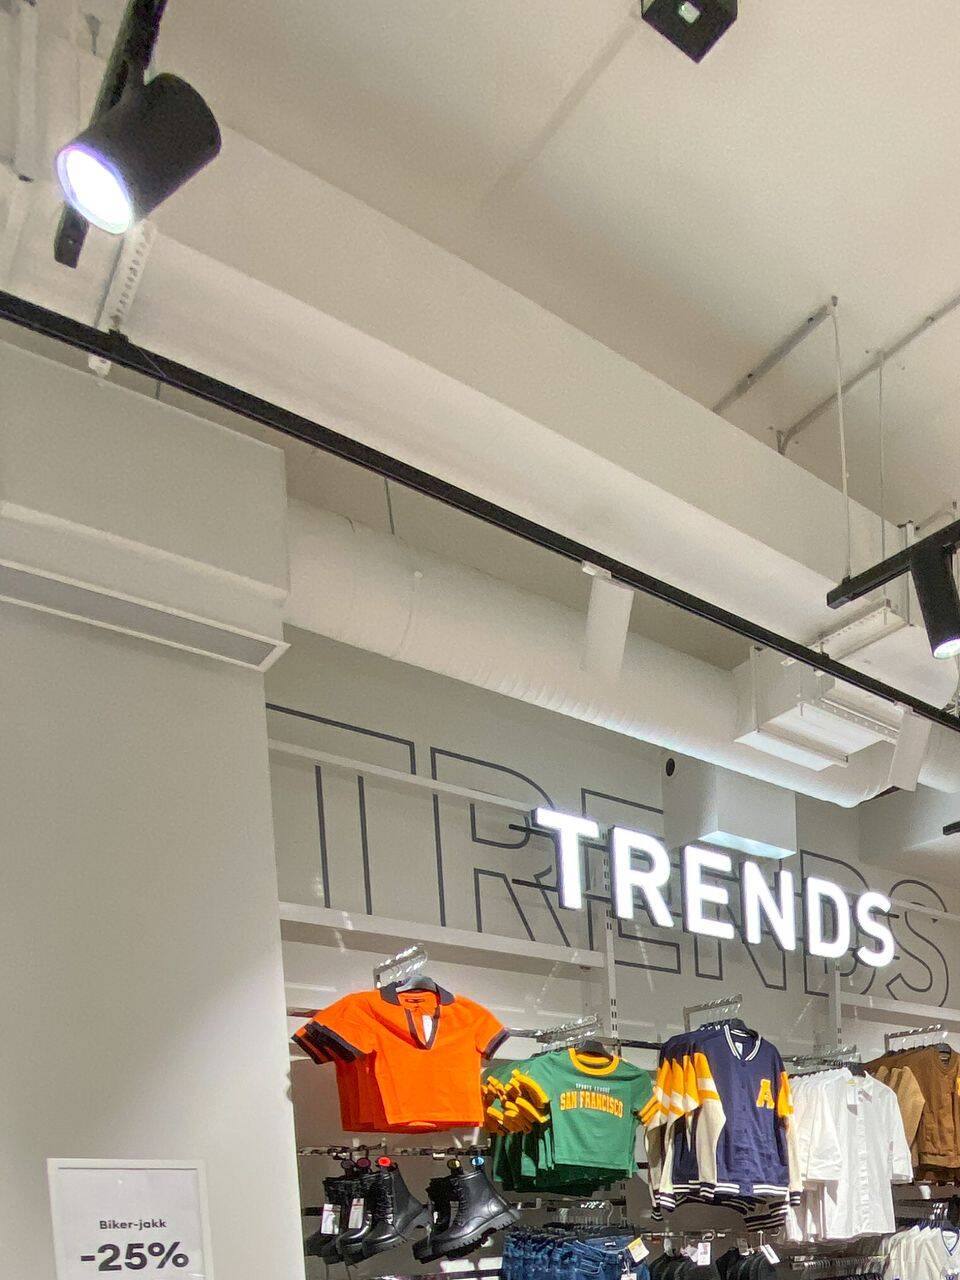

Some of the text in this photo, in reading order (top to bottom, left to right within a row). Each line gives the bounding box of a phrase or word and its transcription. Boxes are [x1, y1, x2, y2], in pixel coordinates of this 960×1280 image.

[531, 807, 896, 968] TRENDS
[560, 1091, 624, 1119] SAN FRANCISCO
[756, 1078, 775, 1109] A
[99, 1219, 167, 1231] Biker-jakk
[80, 1241, 189, 1272] -25%
